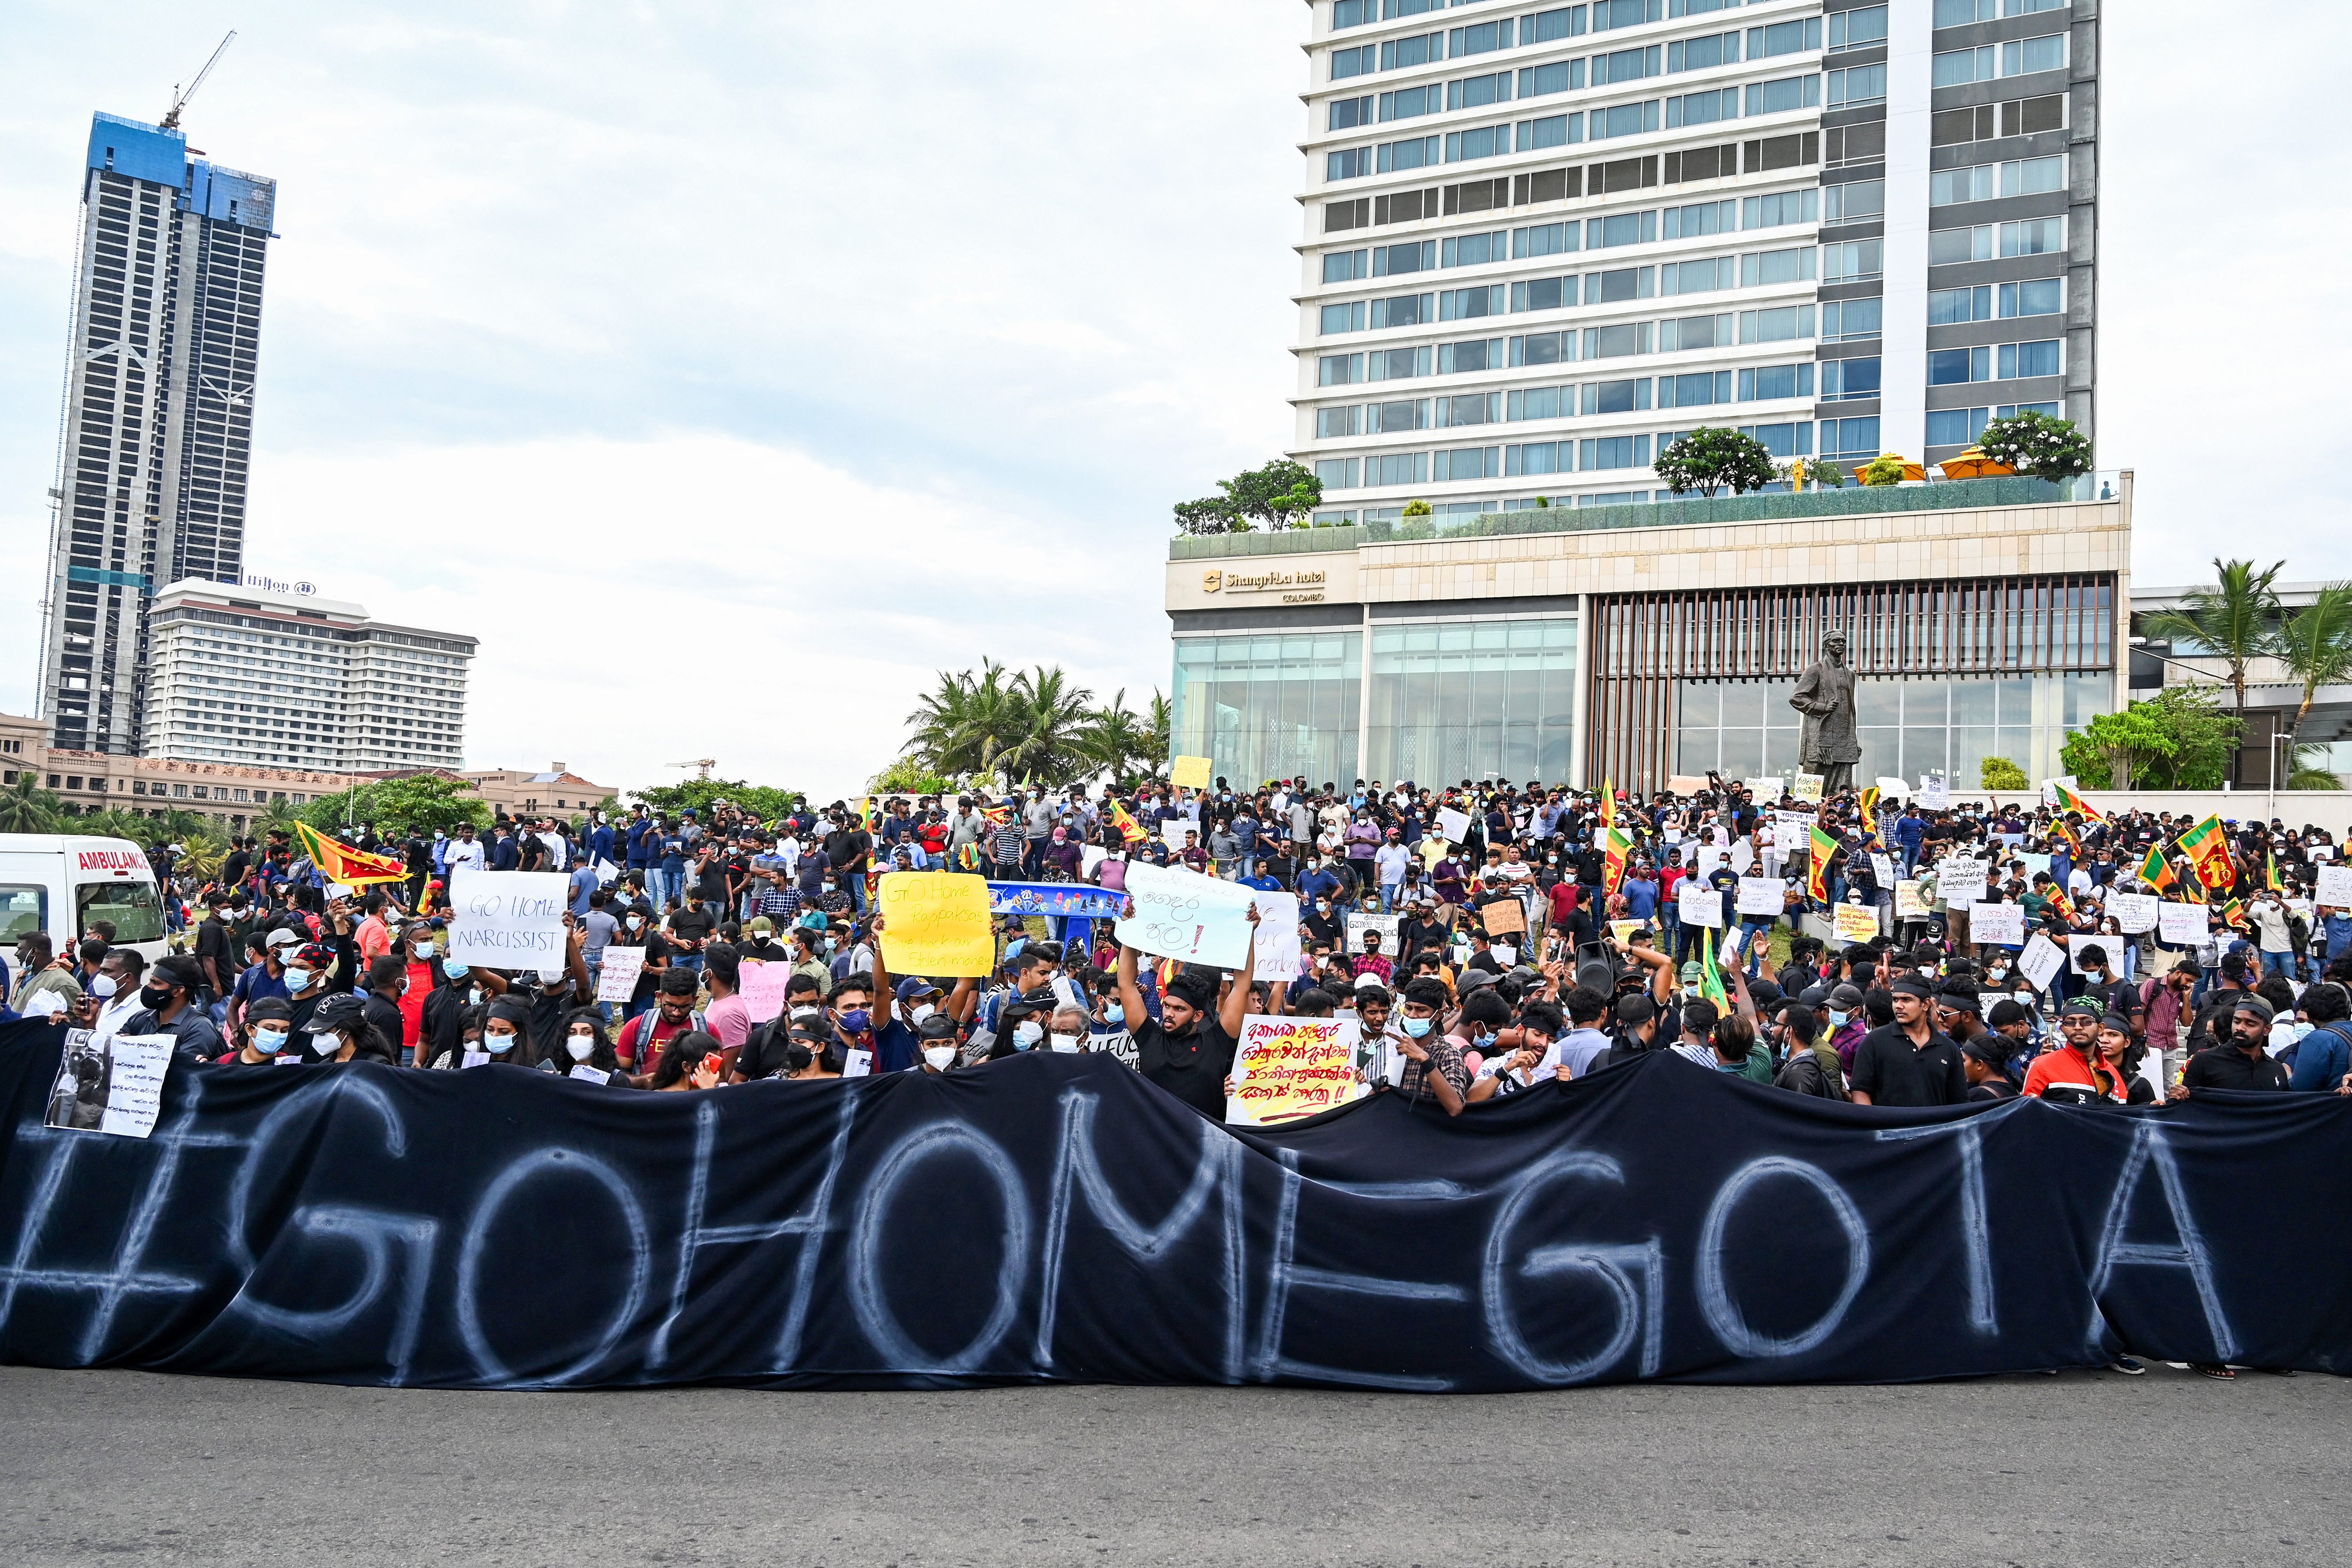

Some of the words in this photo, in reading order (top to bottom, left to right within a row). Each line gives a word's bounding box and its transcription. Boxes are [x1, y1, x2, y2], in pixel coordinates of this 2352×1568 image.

[248, 575, 289, 590] Hilton
[1296, 570, 1325, 583] hotel
[1283, 593, 1324, 602] COLOMBO
[78, 852, 149, 870] AMBULANCE
[885, 877, 925, 902] GO
[931, 877, 969, 900] Home
[470, 895, 501, 917] GO
[511, 896, 557, 917] HOME
[1484, 903, 1503, 913] STAND
[910, 903, 983, 932] Rajapaksas
[458, 929, 561, 951] NARCISSIST
[920, 934, 949, 949] back
[954, 937, 971, 947] our
[908, 951, 946, 968] Stolen
[951, 953, 990, 973] money
[1248, 1023, 1296, 1041] අනාගත
[1105, 1035, 1139, 1056] FUC
